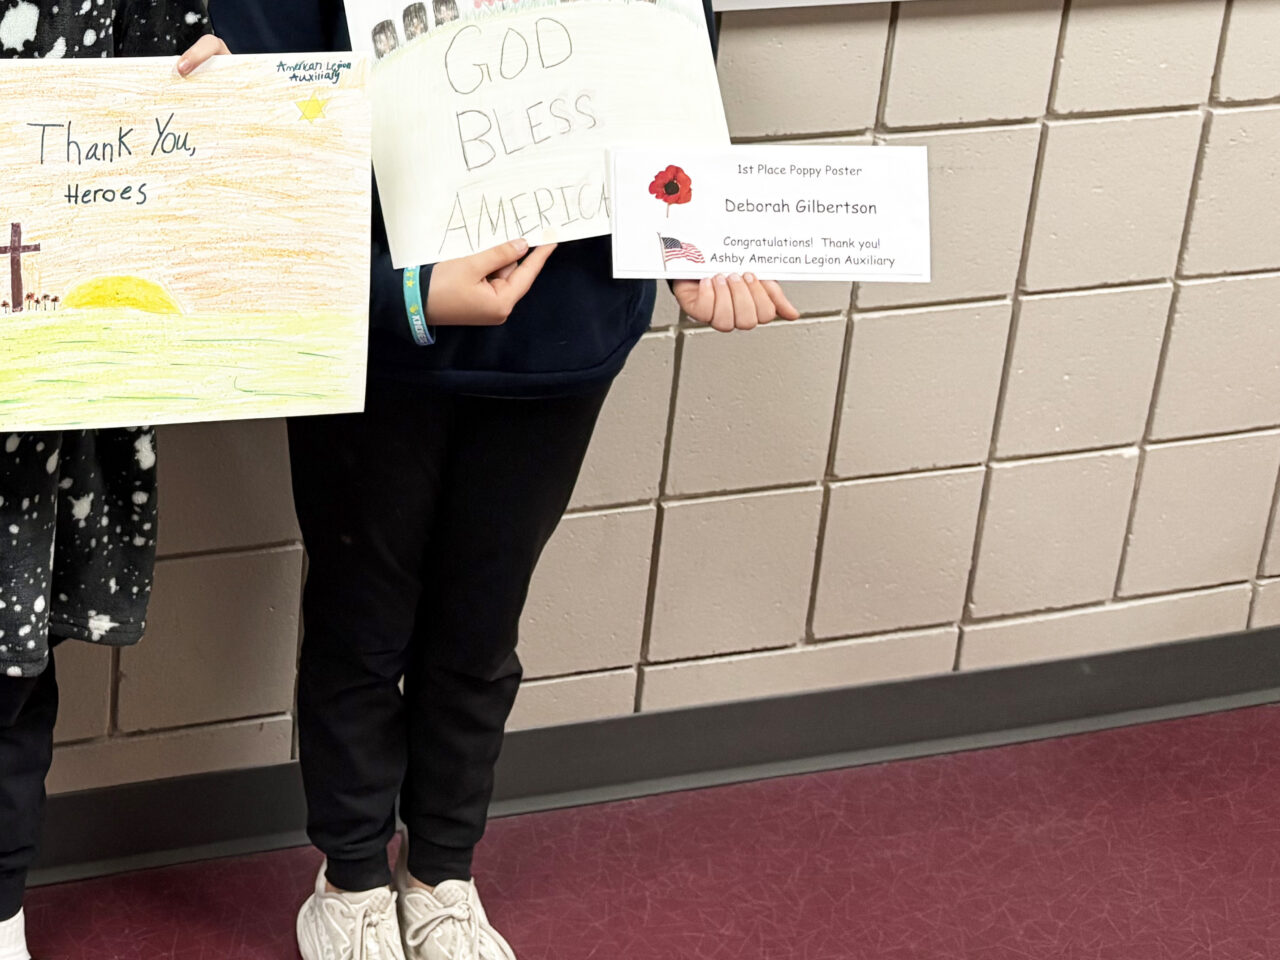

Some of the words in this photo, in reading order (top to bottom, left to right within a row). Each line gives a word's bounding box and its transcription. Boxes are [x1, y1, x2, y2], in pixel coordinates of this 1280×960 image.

[444, 17, 573, 95] GOD
[150, 112, 197, 157] You,
[455, 93, 598, 172] BLESS
[737, 164, 754, 175] 1st
[757, 164, 787, 176] Place
[790, 164, 822, 179] Poppy
[825, 165, 863, 176] Poster
[64, 183, 147, 205] Heroes
[725, 198, 790, 213] Deborah
[795, 199, 877, 215] Gilbertson
[438, 181, 611, 256] AMERICA
[723, 236, 814, 249] Congratulations!
[820, 237, 855, 249] Thank
[858, 238, 881, 251] you!
[710, 252, 745, 266] Ashby
[748, 252, 802, 265] American
[804, 254, 841, 268] Legion
[844, 255, 896, 269] Auxiliary
